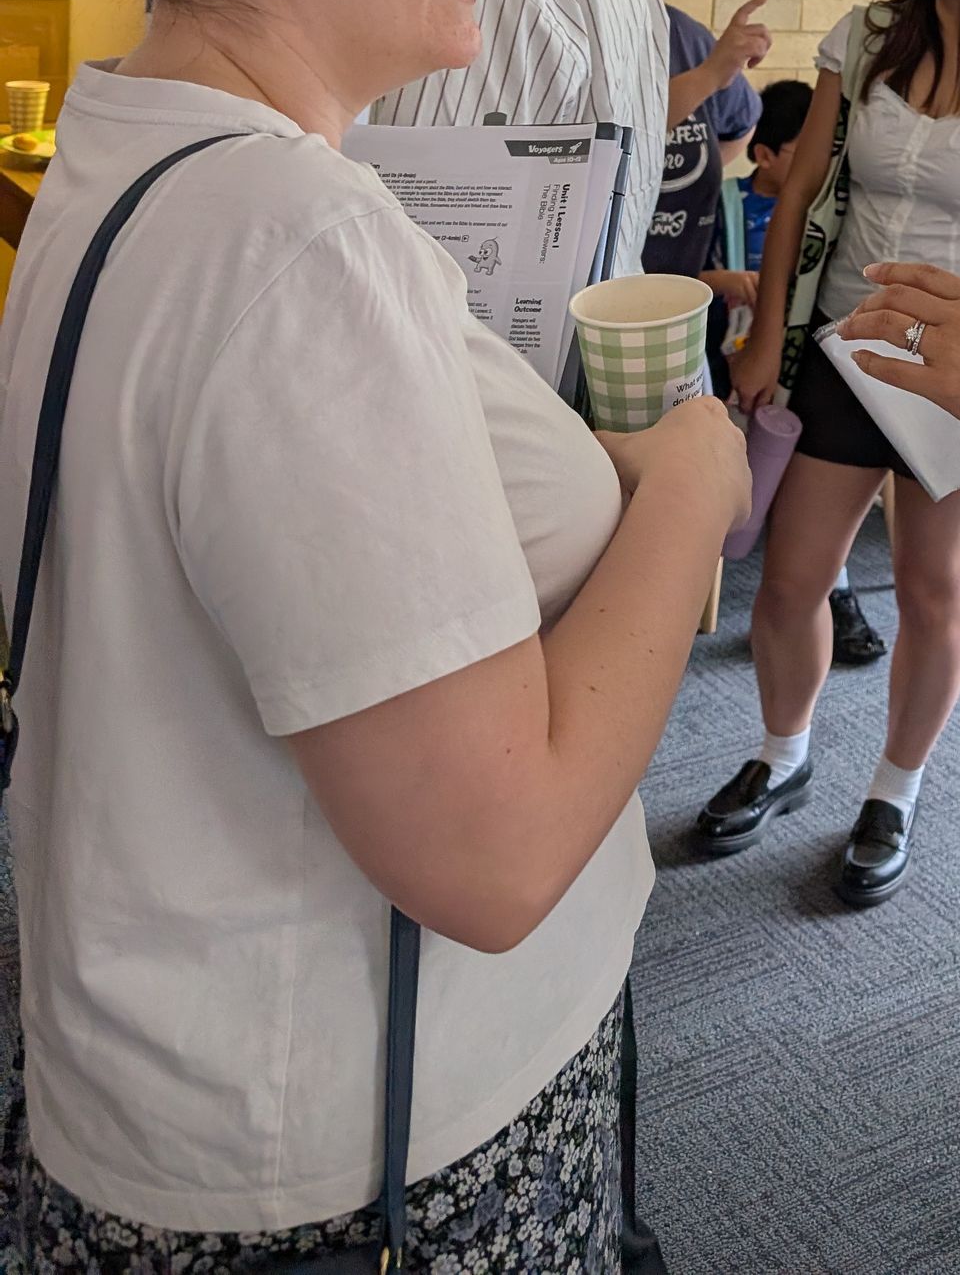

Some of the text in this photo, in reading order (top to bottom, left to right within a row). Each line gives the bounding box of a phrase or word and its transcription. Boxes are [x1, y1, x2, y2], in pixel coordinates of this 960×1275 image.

[528, 144, 563, 155] Voyagers
[547, 184, 561, 212] Finding
[560, 183, 571, 204] Unit
[546, 213, 555, 227] the
[552, 211, 566, 244] Lesson
[513, 305, 542, 313] Outcome
[515, 297, 543, 306] Learning
[676, 377, 696, 393] What
